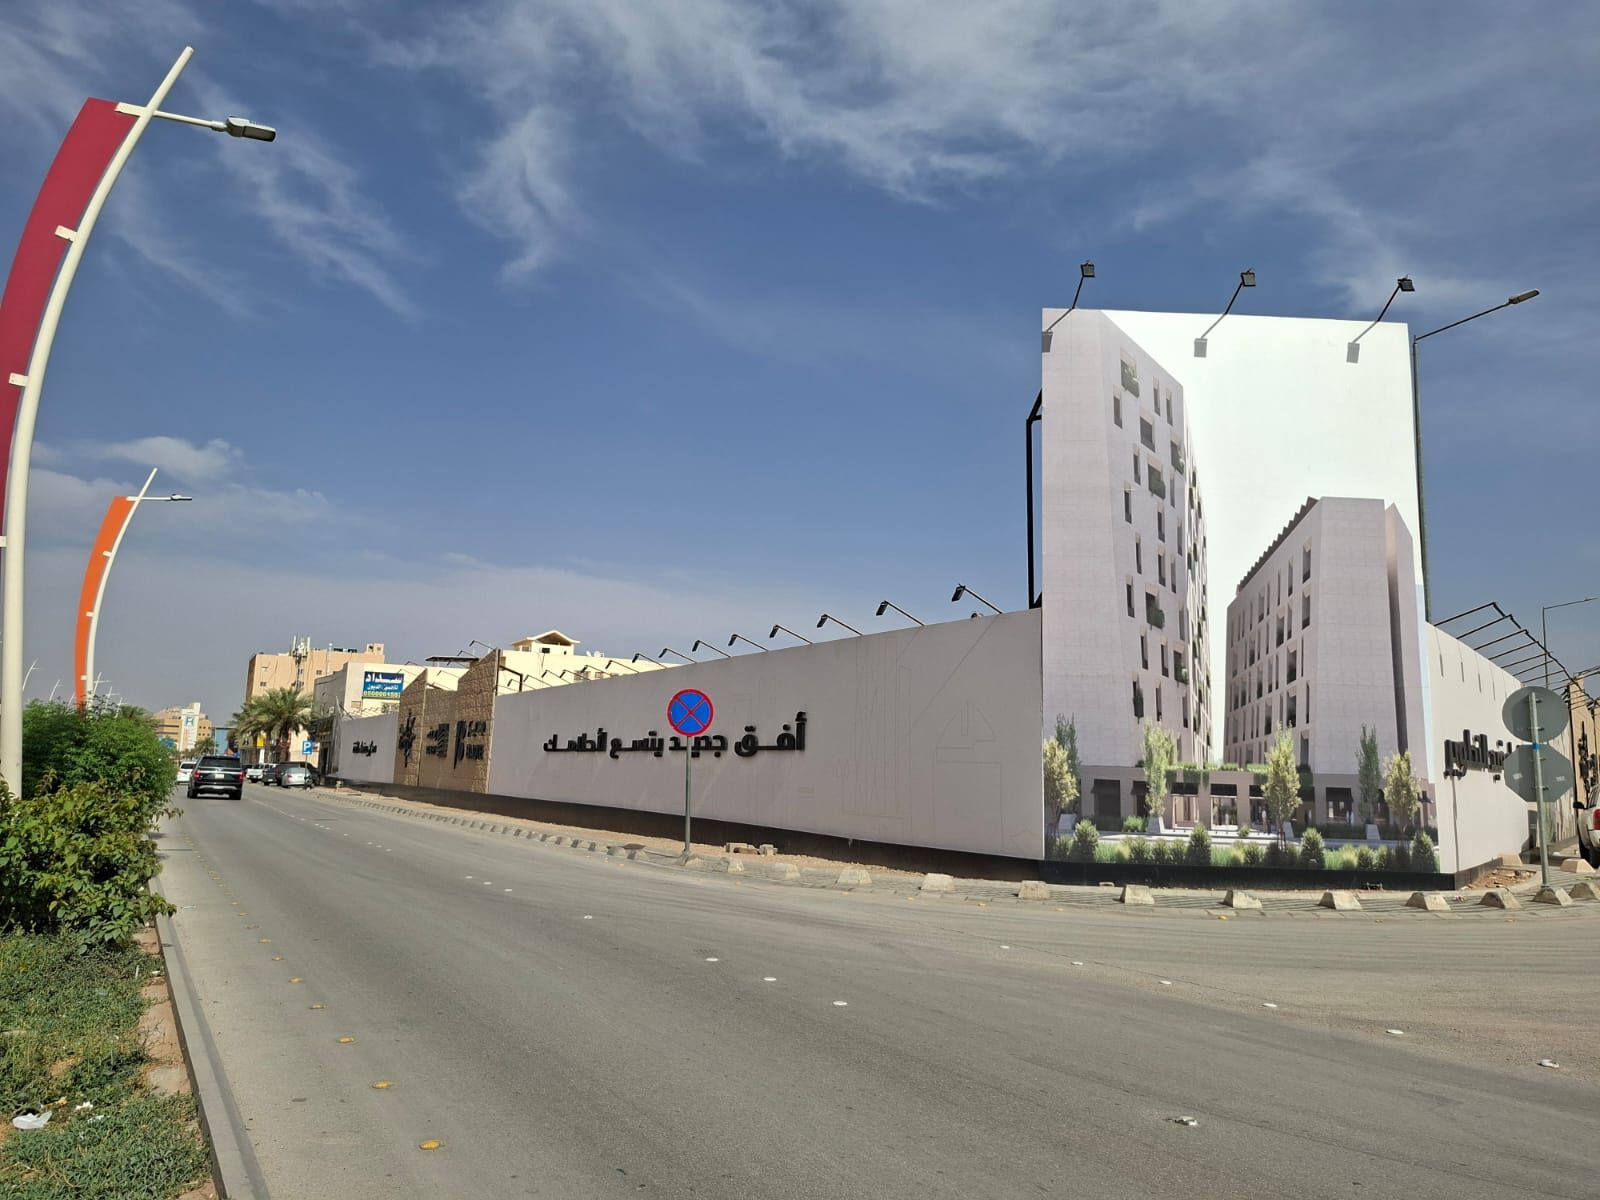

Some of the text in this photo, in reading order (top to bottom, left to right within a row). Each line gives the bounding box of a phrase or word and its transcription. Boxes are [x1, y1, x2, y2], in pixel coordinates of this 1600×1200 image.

[303, 741, 312, 752] P
[609, 730, 665, 759] يتسع
[668, 735, 728, 758] جديد
[734, 711, 807, 757] أفق
